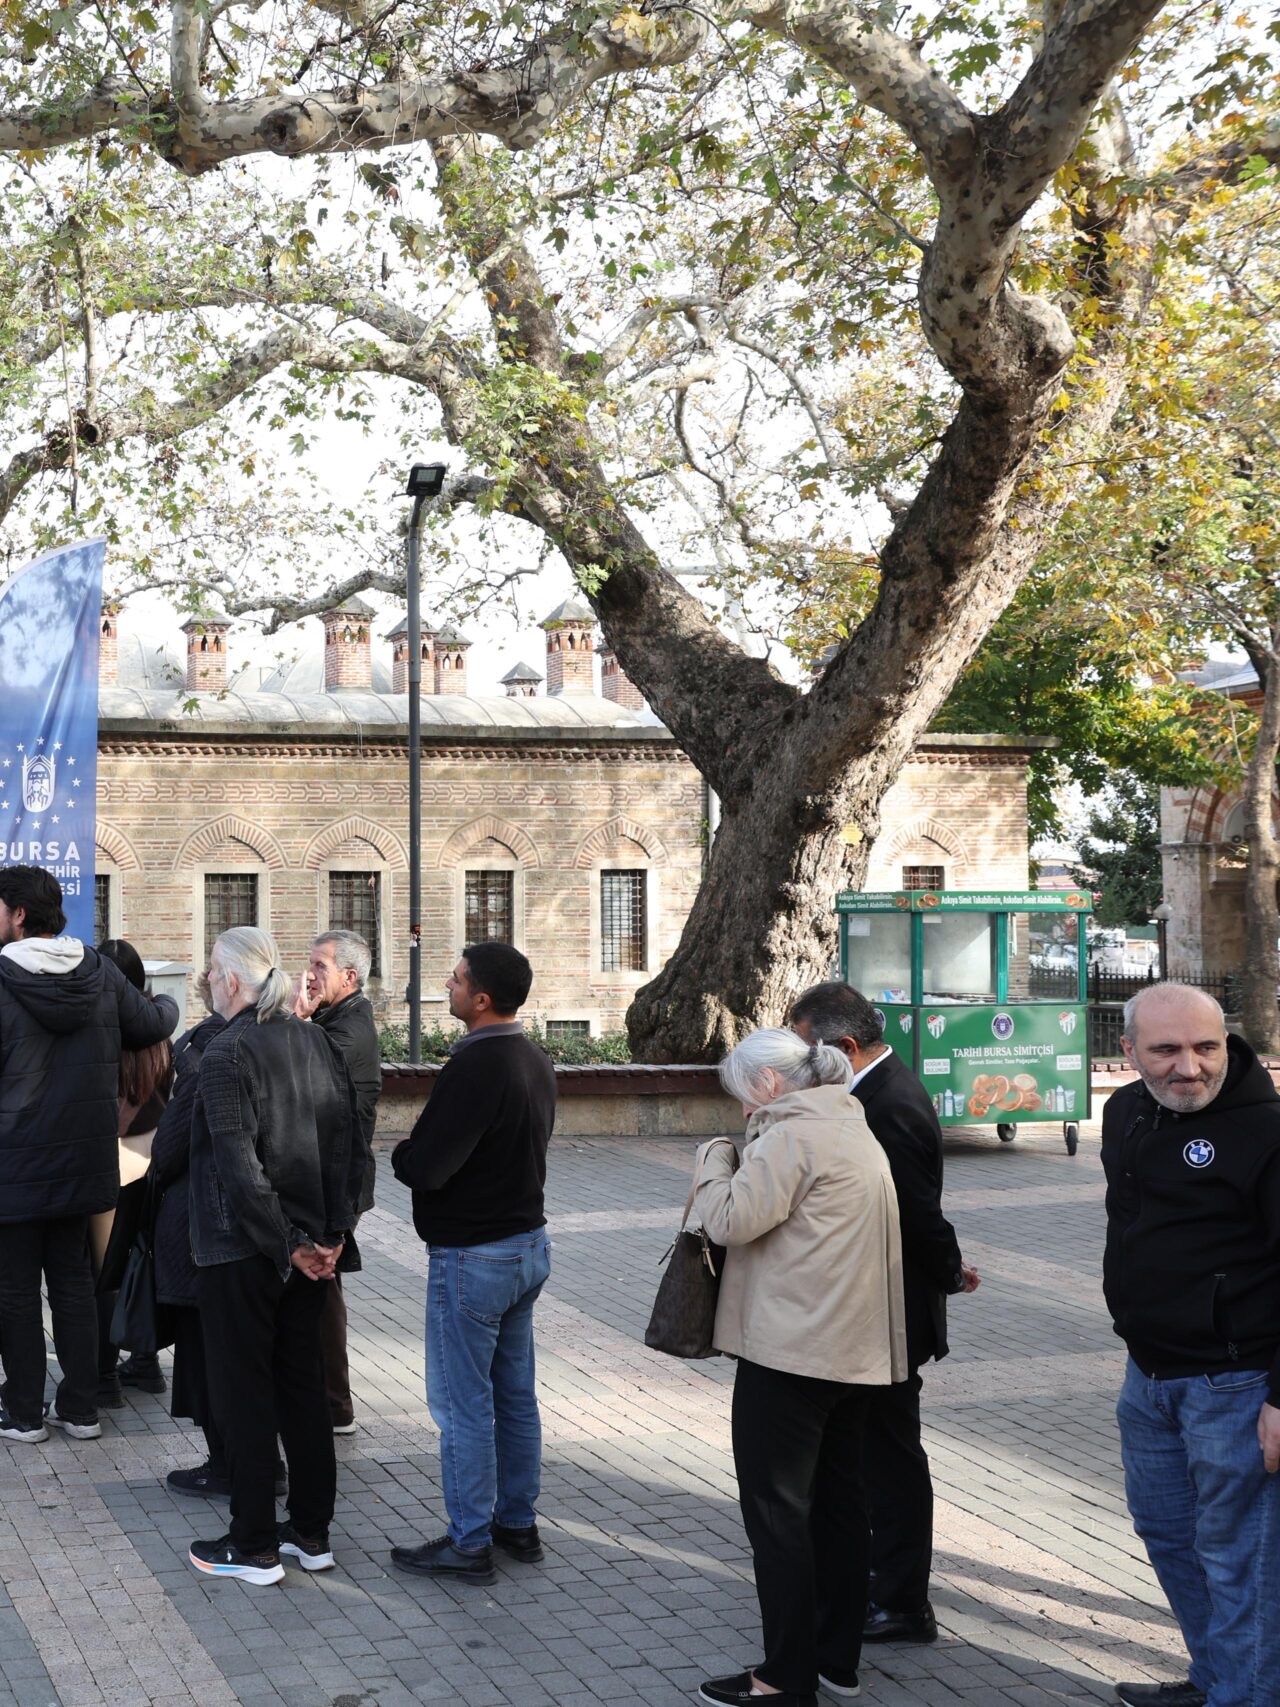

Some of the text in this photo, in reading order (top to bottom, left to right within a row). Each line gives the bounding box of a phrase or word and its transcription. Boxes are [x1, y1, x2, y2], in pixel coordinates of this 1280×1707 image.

[952, 1044, 1054, 1058] TARİHİ BURSA SİMİTÇİSİ
